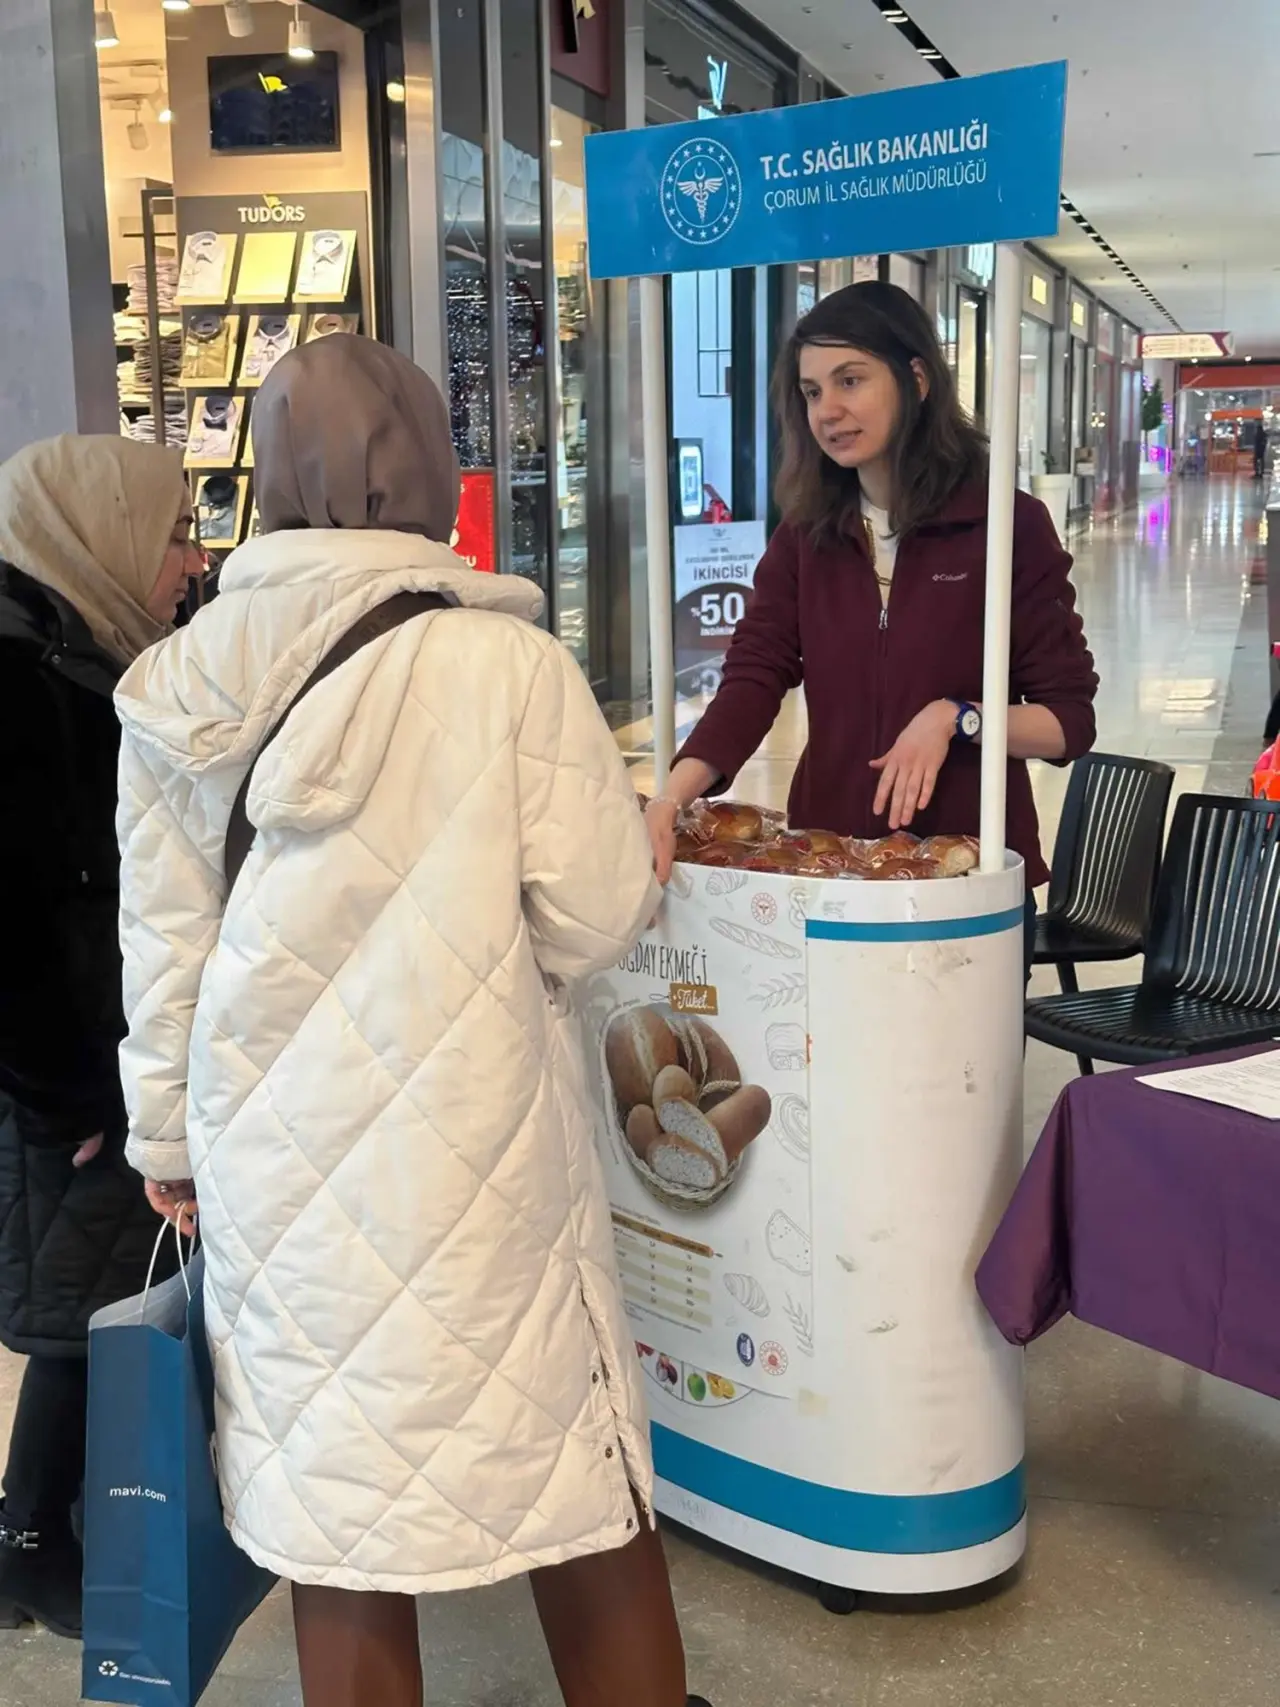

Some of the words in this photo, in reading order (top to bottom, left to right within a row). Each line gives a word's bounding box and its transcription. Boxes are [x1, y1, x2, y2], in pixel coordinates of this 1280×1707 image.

[760, 156, 798, 180] T.C.
[803, 141, 873, 175] SAĞLIK
[878, 118, 988, 163] BAKANLIĞI
[764, 186, 820, 215] ÇORUM
[825, 180, 838, 202] İL
[841, 176, 890, 201] SAĞLIK
[892, 158, 988, 193] MÜDÜRLÜĞÜ
[238, 205, 306, 223] TUDORS
[693, 564, 748, 581] İKİNCİSİ
[109, 1485, 167, 1503] mavi.com
